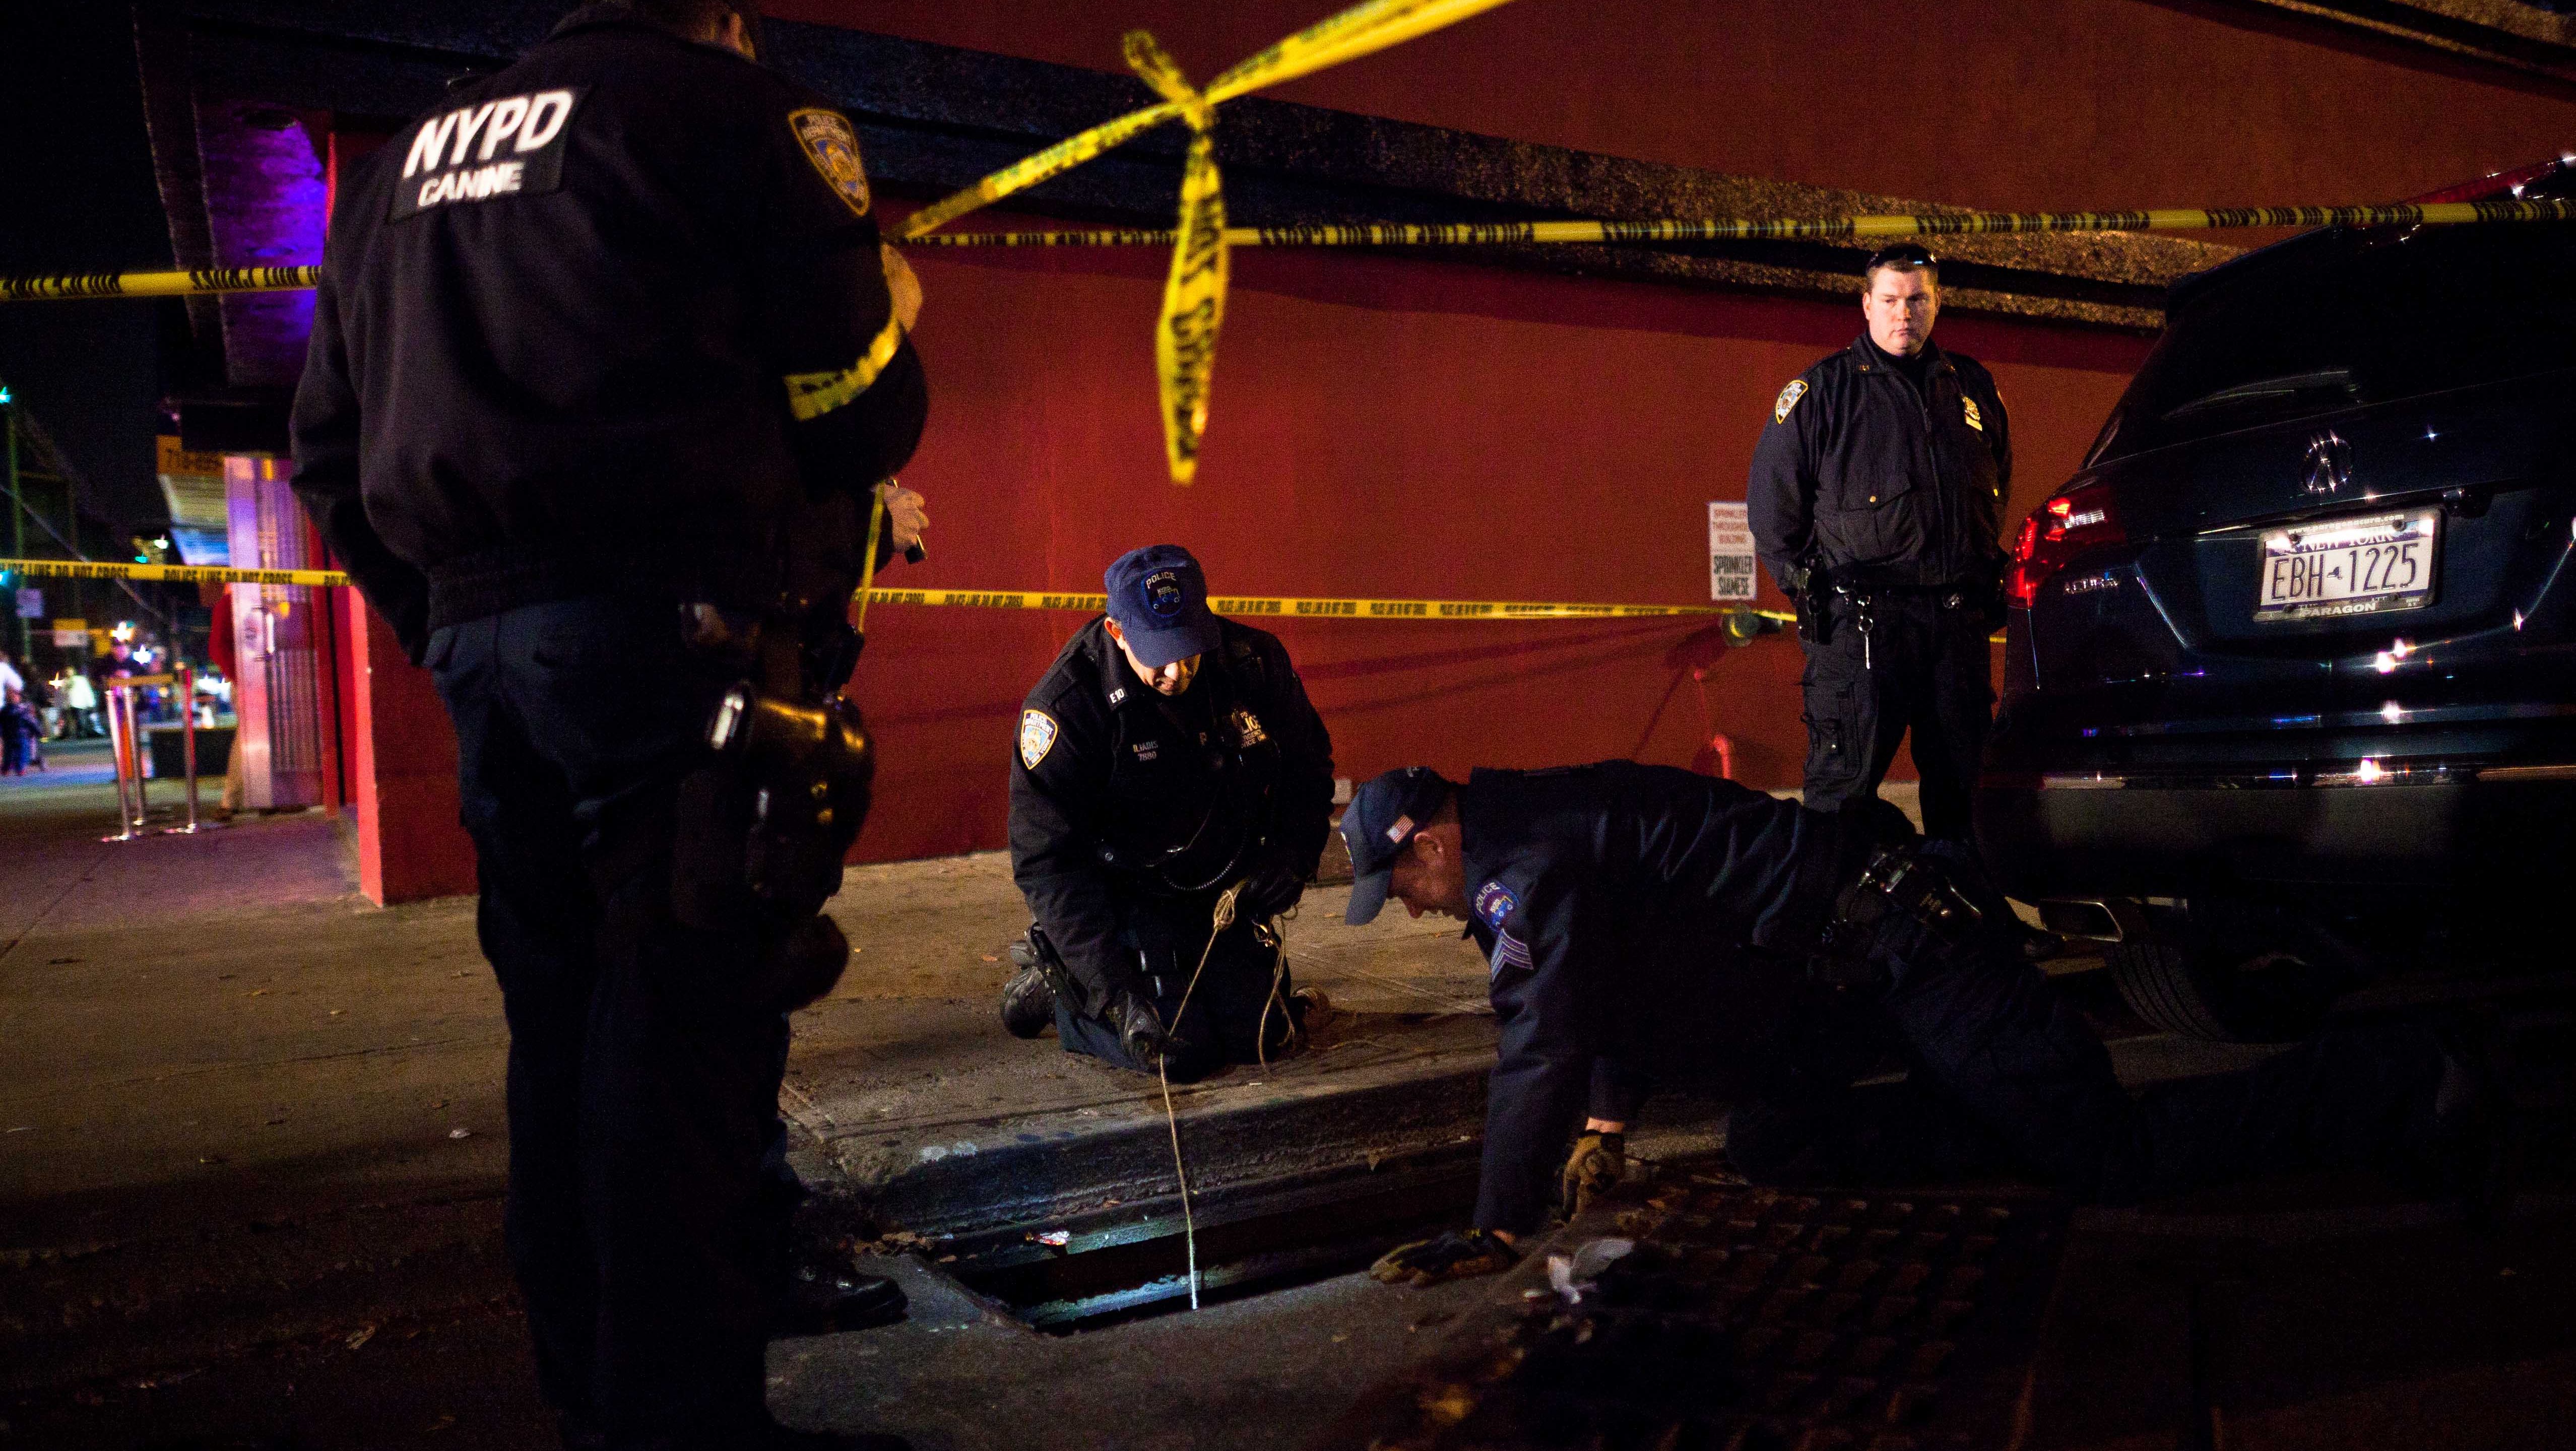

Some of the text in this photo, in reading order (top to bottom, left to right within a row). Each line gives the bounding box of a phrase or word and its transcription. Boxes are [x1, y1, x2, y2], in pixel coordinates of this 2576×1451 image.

[403, 91, 574, 179] NYPD
[417, 161, 525, 207] CANINE
[1714, 555, 1754, 575] SPRINKLER
[2271, 543, 2419, 602] EBH 1225
[1146, 571, 1177, 589] POLICE
[2299, 602, 2376, 617] PARAGON
[1109, 688, 1125, 704] E10
[1476, 882, 1501, 915] POLICE
